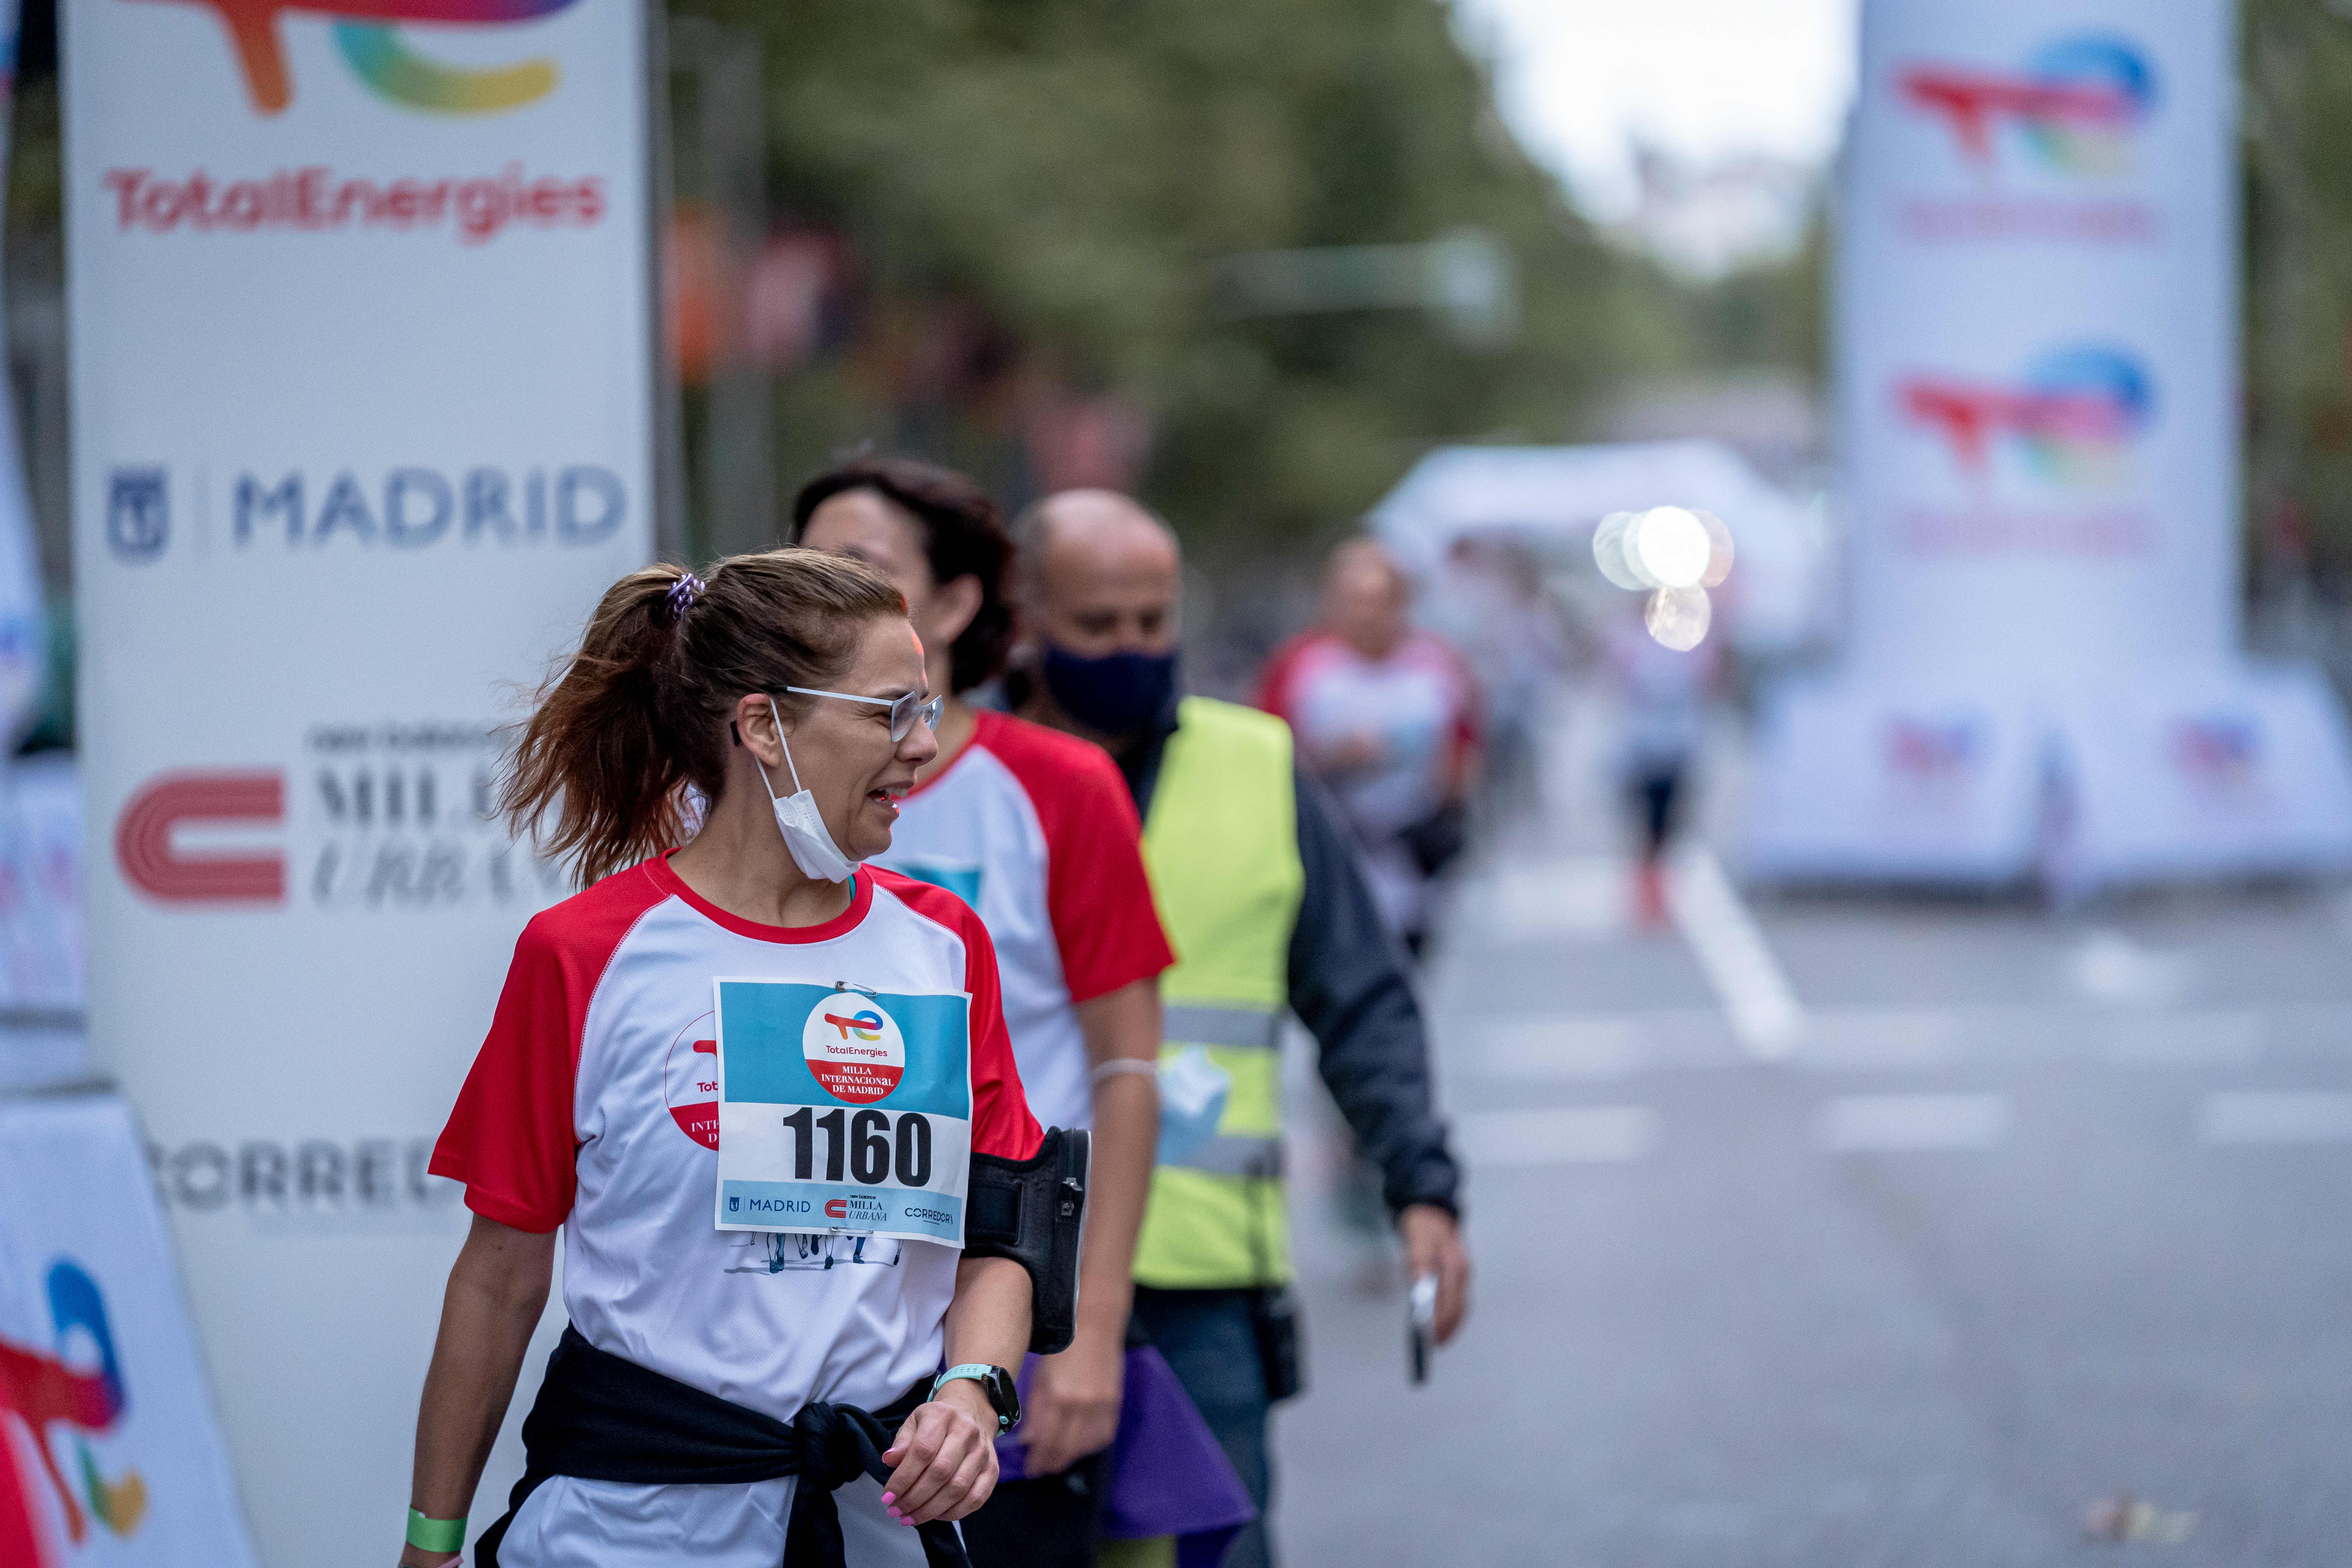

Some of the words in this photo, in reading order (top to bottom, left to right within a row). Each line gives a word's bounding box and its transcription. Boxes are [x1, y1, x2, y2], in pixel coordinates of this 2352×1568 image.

[104, 162, 604, 244] TotalEnergies
[234, 466, 627, 547] MADRID
[826, 1045, 887, 1057] TotalEnergies
[842, 1066, 872, 1075] MILLA
[833, 1084, 846, 1093] DE
[848, 1085, 884, 1095] MADRID
[783, 1107, 931, 1188] 1160
[750, 1199, 811, 1212] MADRID
[849, 1200, 883, 1210] MILLA
[849, 1210, 888, 1221] URBANA
